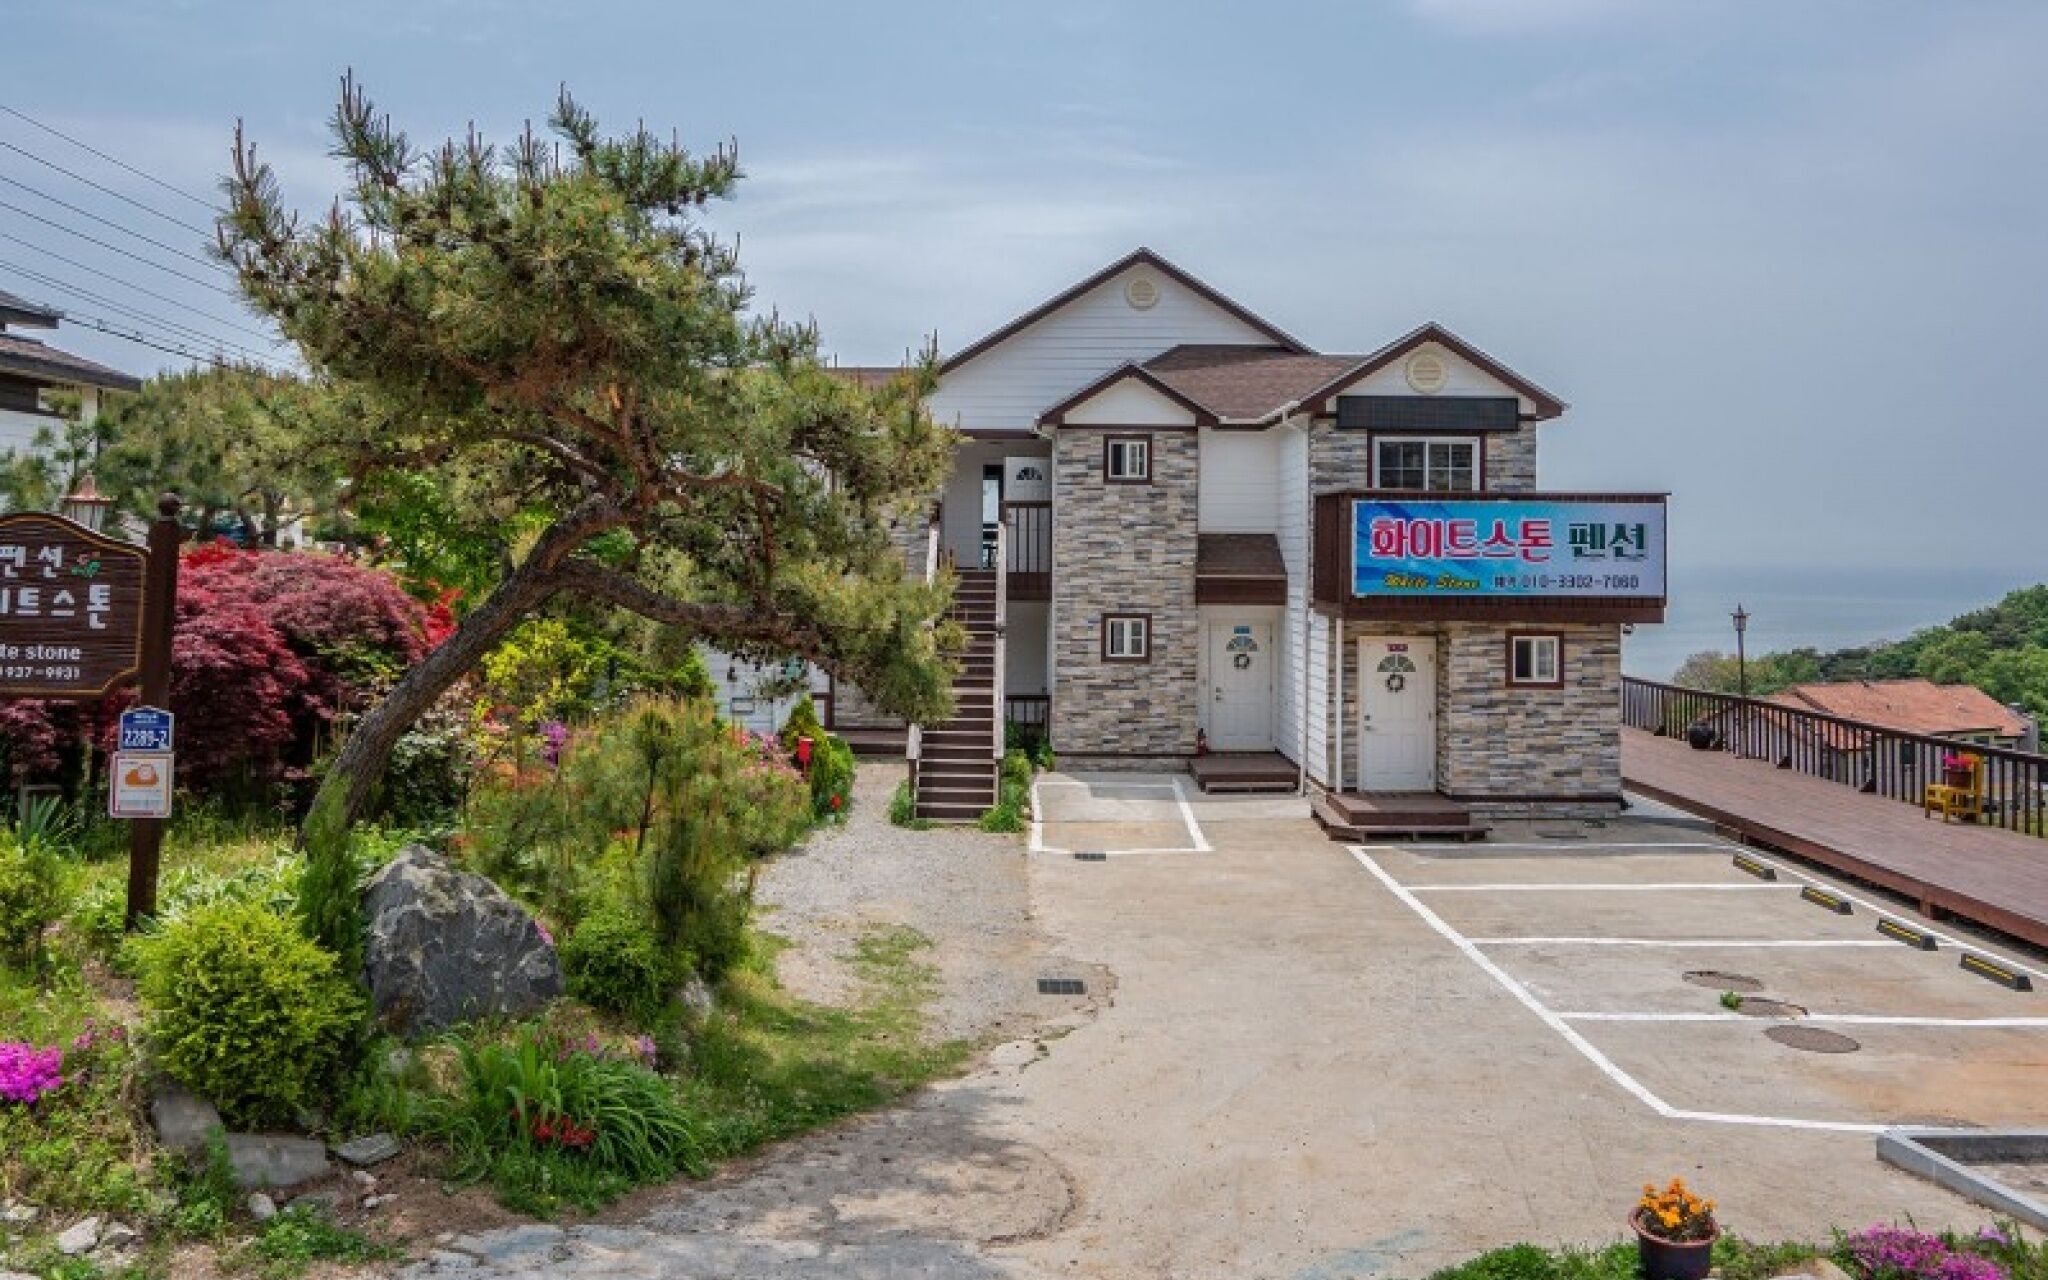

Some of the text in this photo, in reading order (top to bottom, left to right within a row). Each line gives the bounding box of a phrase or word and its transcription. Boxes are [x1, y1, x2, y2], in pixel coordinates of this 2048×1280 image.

[1370, 517, 1647, 562] 화이트스톤 펜션
[25, 645, 81, 660] stone
